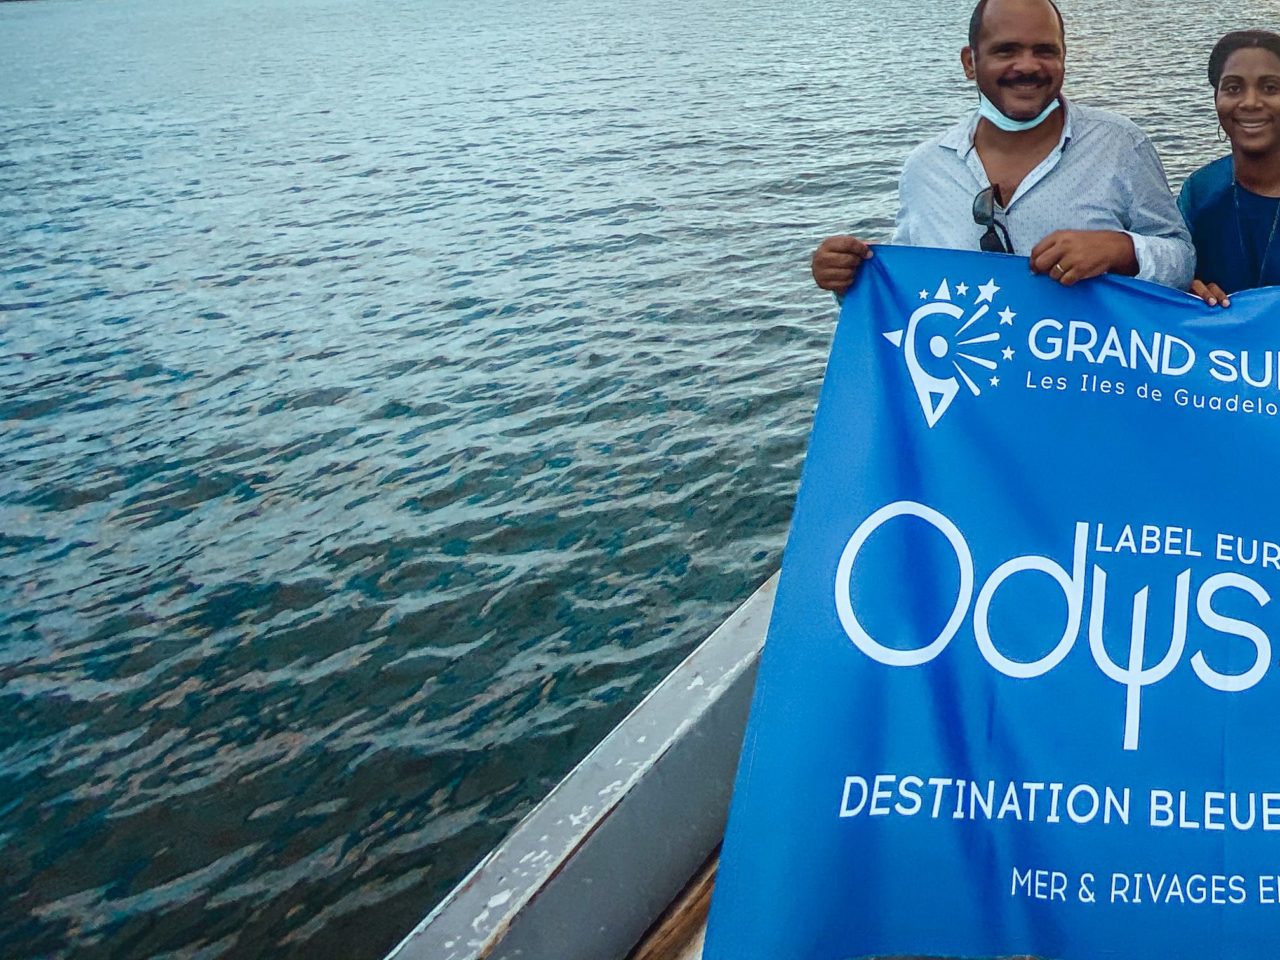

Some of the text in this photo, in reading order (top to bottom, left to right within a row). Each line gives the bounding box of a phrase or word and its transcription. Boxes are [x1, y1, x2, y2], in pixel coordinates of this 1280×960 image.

[1028, 318, 1196, 376] GRAND
[1026, 371, 1068, 390] Les
[1081, 374, 1125, 395] Iles
[1136, 382, 1162, 401] de
[1095, 523, 1202, 557] LABEL
[839, 773, 1130, 826] DESTINATION
[1011, 867, 1068, 901] MER
[1078, 873, 1096, 903] &
[1110, 873, 1246, 904] RIVAGES
